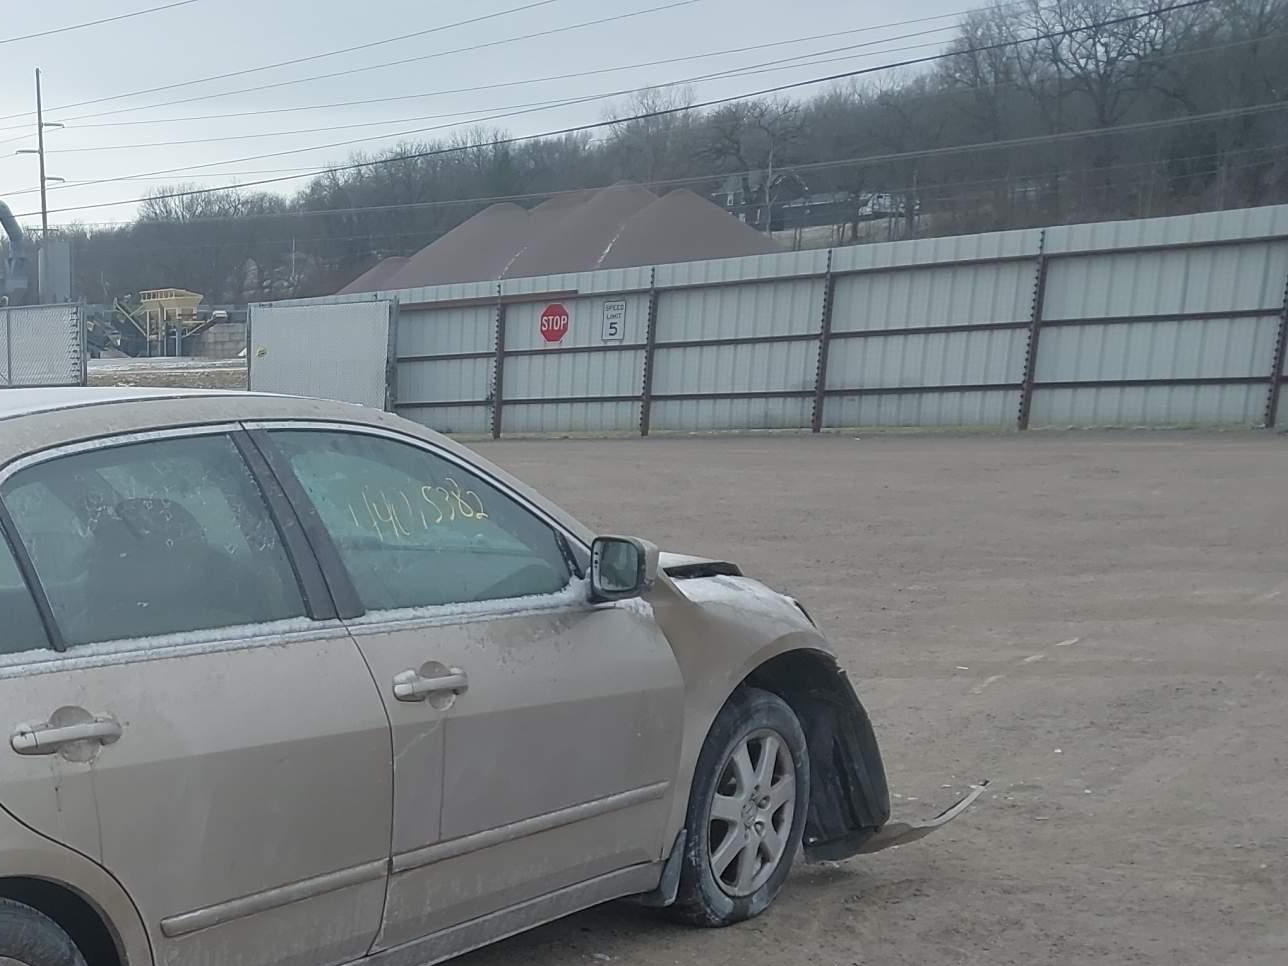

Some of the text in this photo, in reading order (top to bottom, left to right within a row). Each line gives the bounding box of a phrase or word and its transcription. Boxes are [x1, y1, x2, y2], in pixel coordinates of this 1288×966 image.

[605, 304, 625, 312] SPEED
[606, 312, 623, 320] LIMIT
[541, 315, 569, 332] STOP
[608, 321, 619, 337] 5
